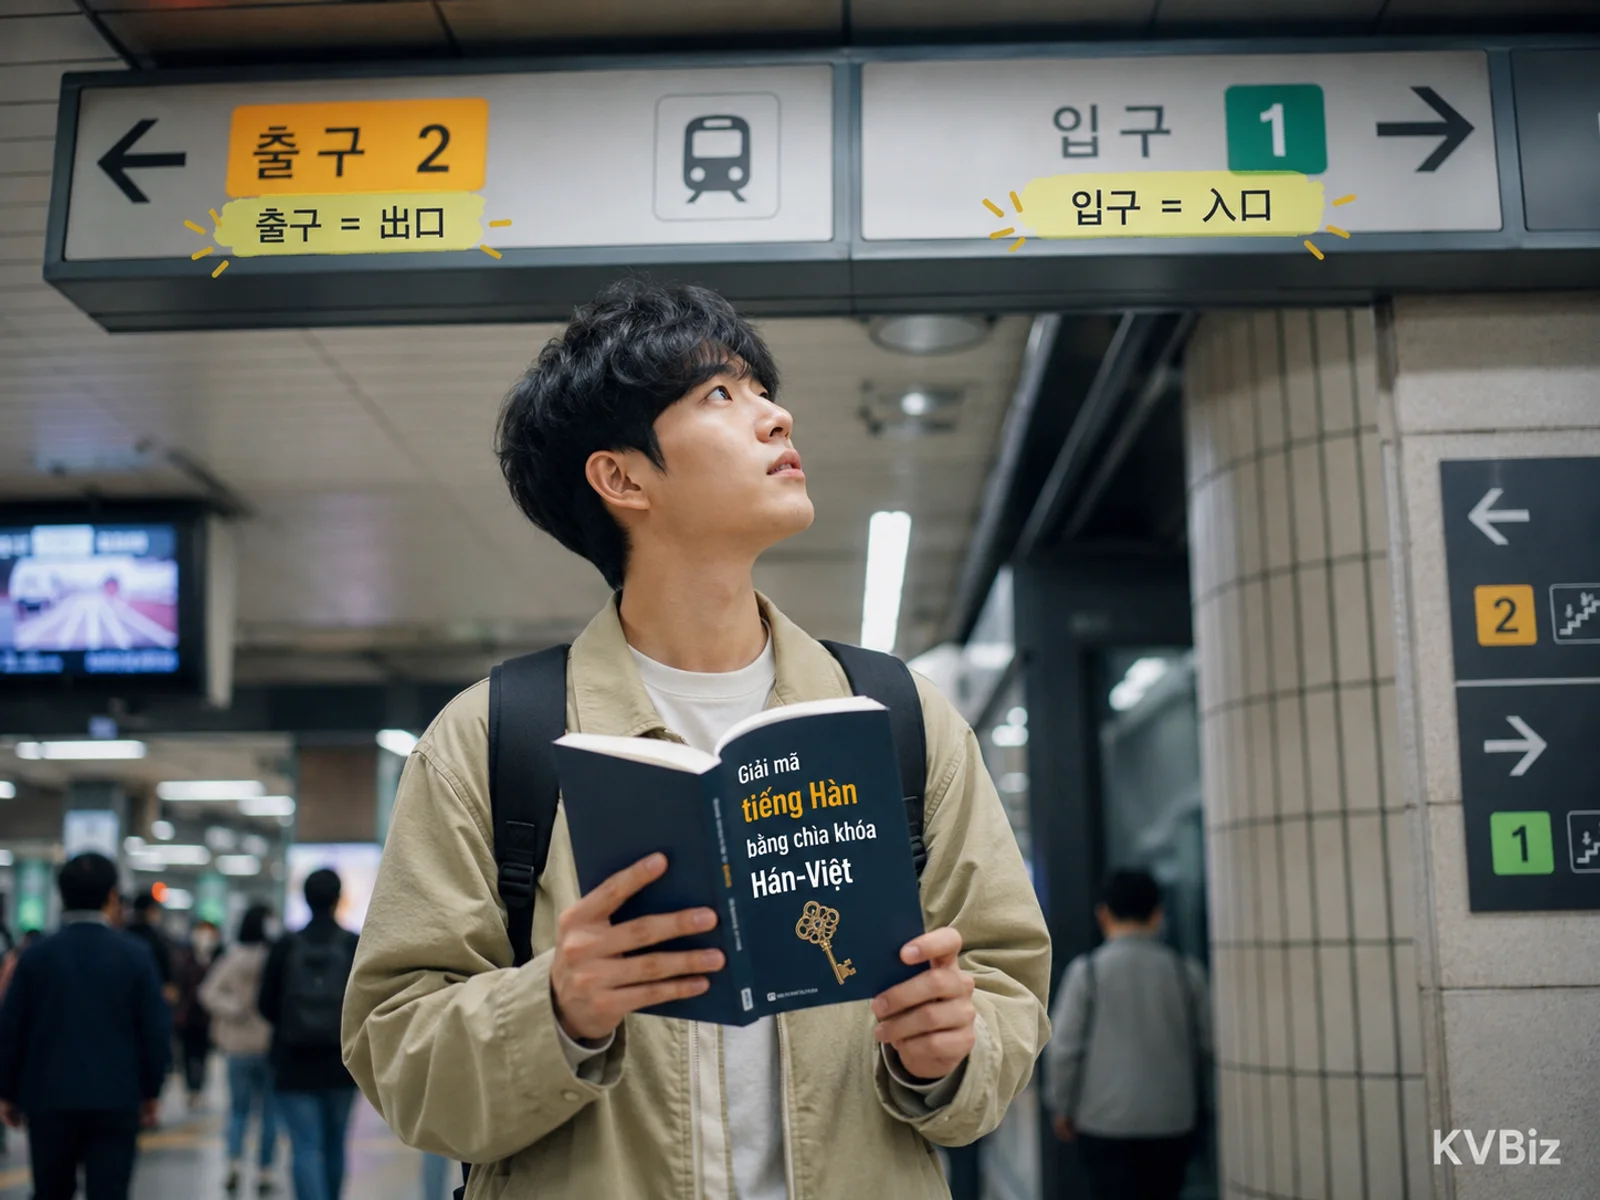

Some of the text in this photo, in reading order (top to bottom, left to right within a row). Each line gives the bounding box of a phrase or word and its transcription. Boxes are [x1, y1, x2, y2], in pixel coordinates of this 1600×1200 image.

[1053, 103, 1286, 159] 입구 1
[253, 123, 451, 180] 출구 2
[1494, 597, 1519, 634] 2
[738, 752, 800, 784] Giải mã
[742, 779, 858, 823] tiếng Hàn
[746, 819, 877, 858] bằng chìa khóa
[1511, 825, 1528, 863] 1
[750, 858, 854, 899] Hán-Việt
